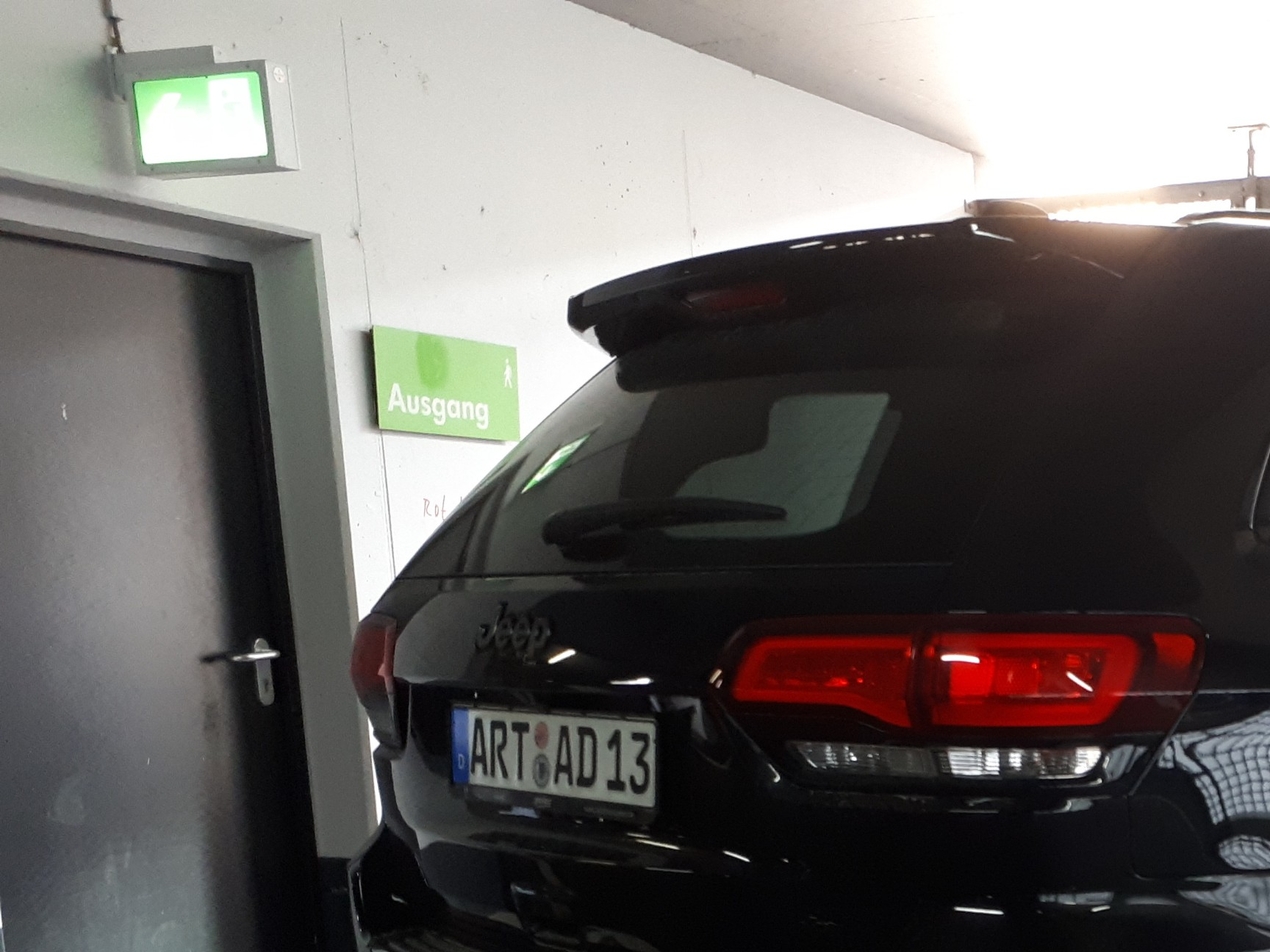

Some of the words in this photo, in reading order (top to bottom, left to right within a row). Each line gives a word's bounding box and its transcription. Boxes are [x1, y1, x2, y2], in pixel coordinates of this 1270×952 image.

[387, 382, 490, 430] Ausgang
[473, 601, 553, 665] Jeep
[470, 717, 530, 781] ART
